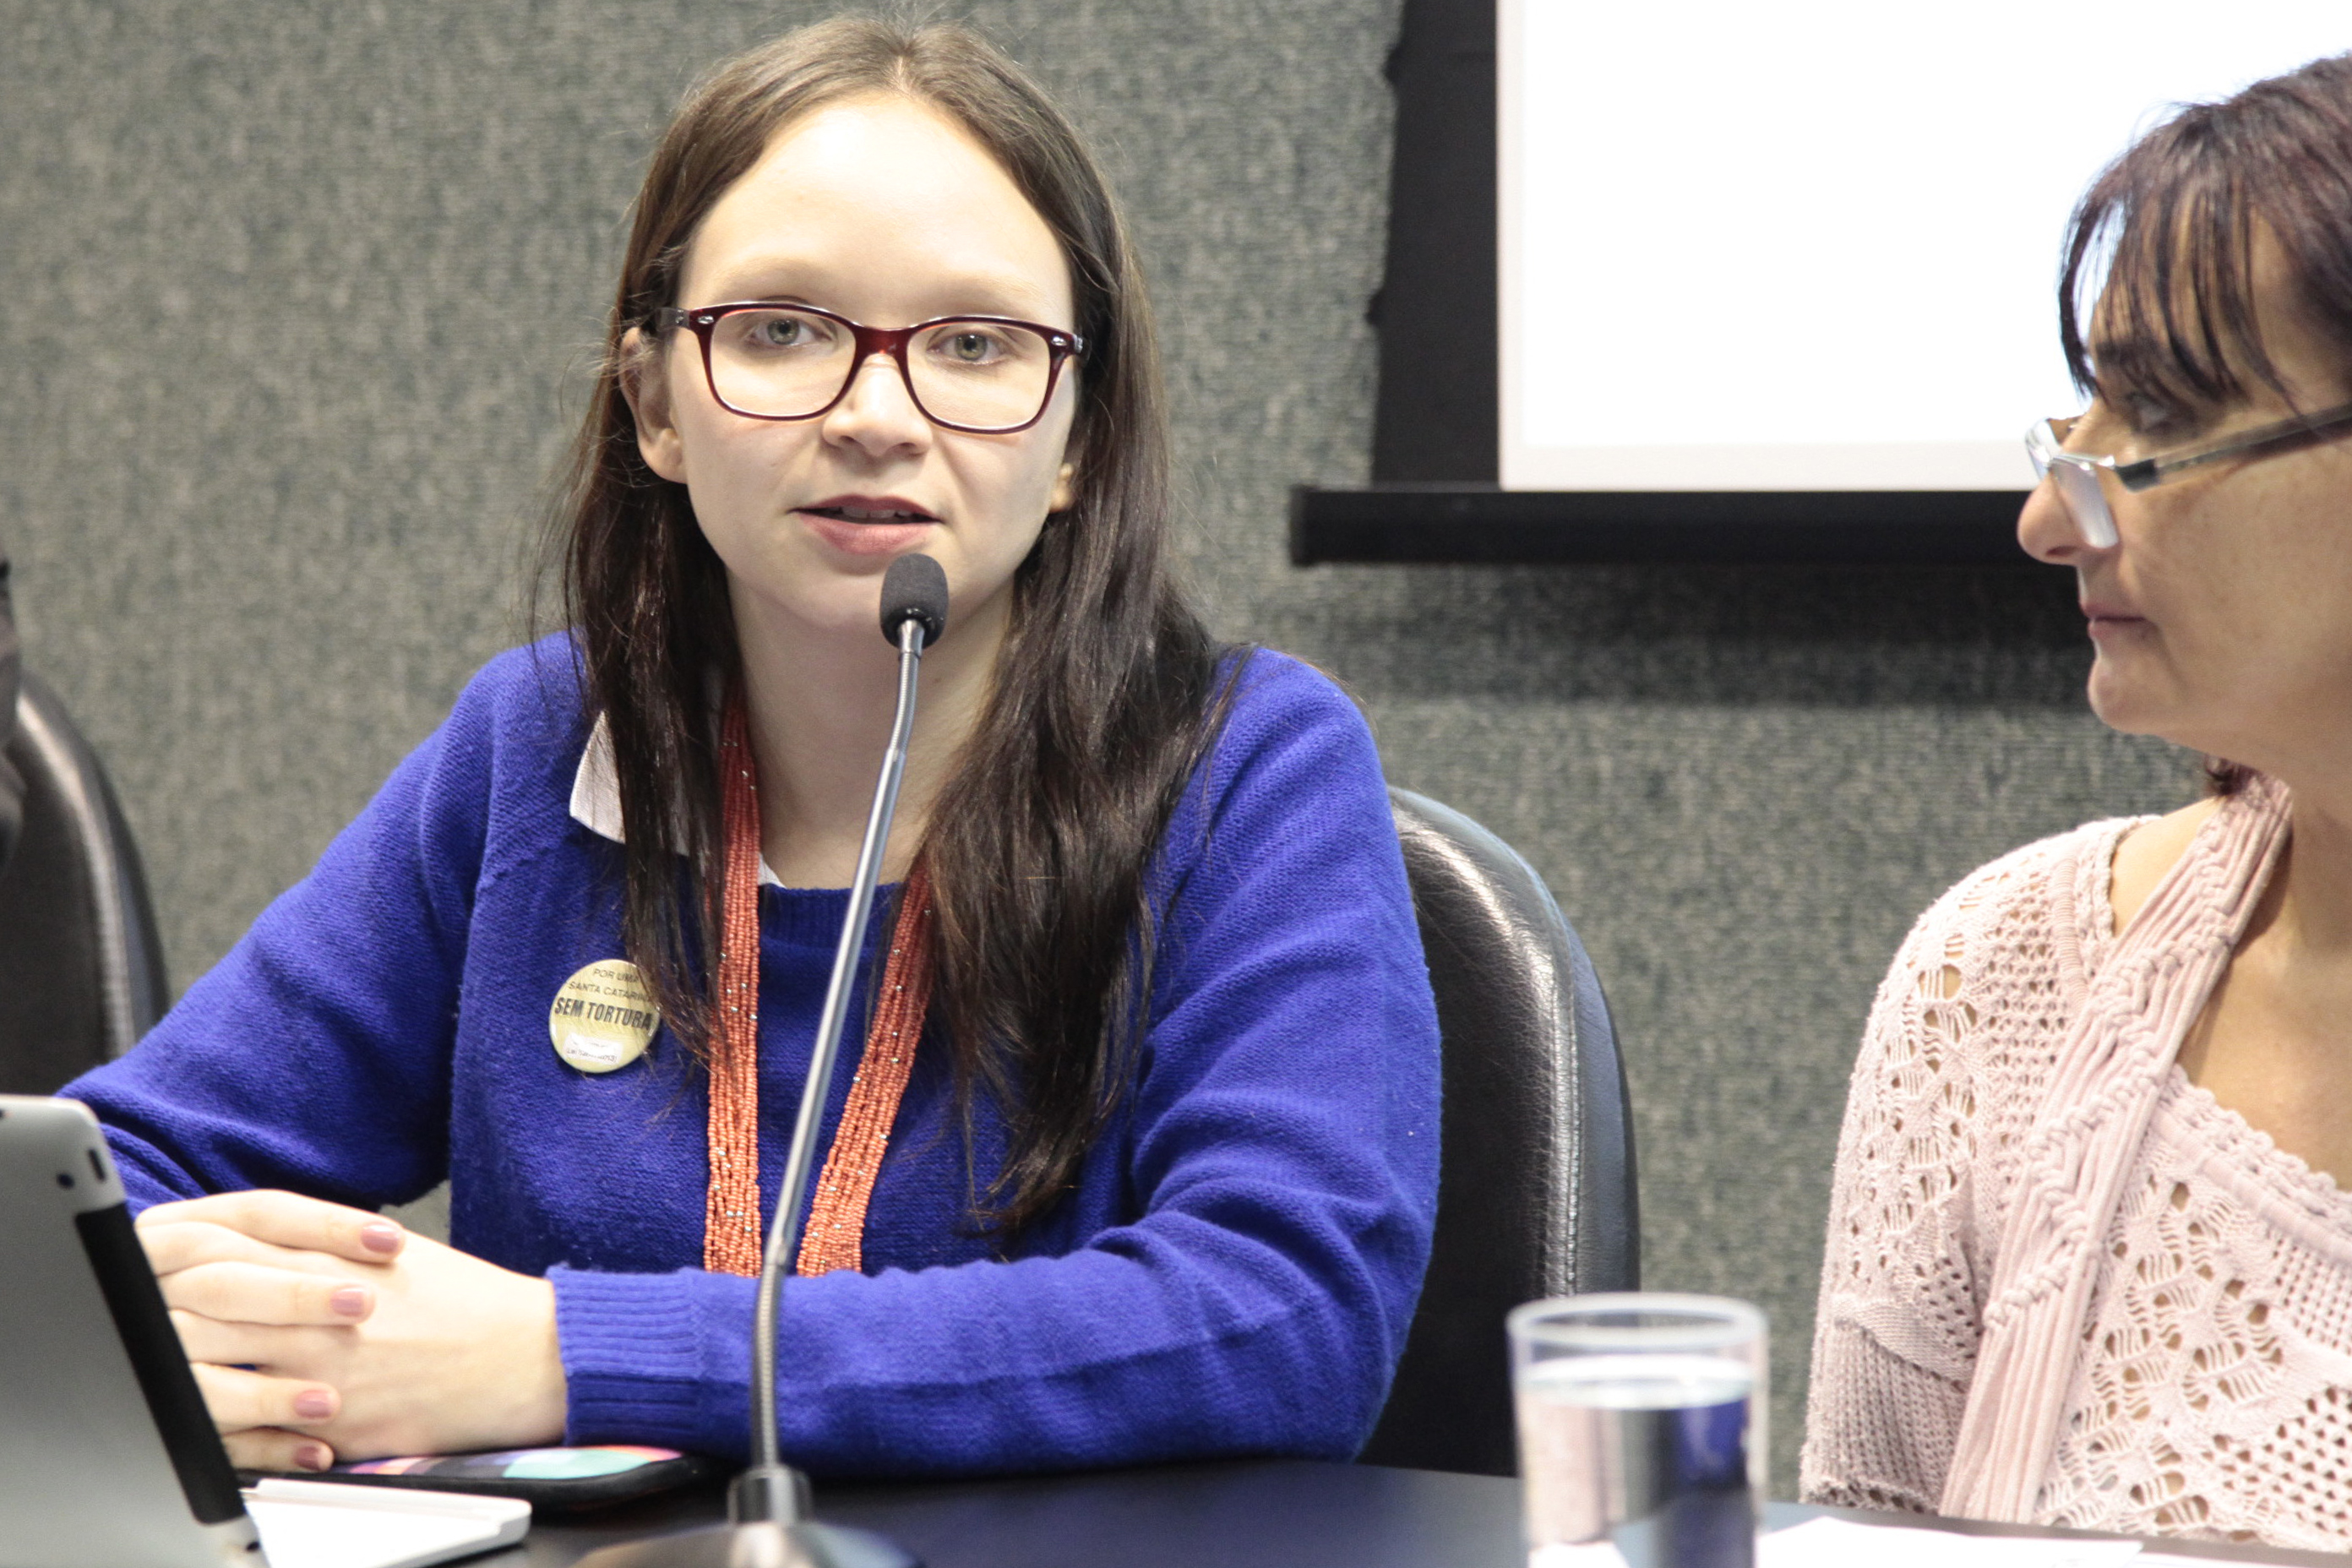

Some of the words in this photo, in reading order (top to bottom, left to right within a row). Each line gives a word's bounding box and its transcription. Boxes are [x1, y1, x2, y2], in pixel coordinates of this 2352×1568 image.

[594, 968, 615, 979] POR
[569, 981, 601, 994] SANTA
[603, 987, 650, 1003] CATARIN
[554, 997, 585, 1017] SEM
[587, 1002, 652, 1030] TORTURA
